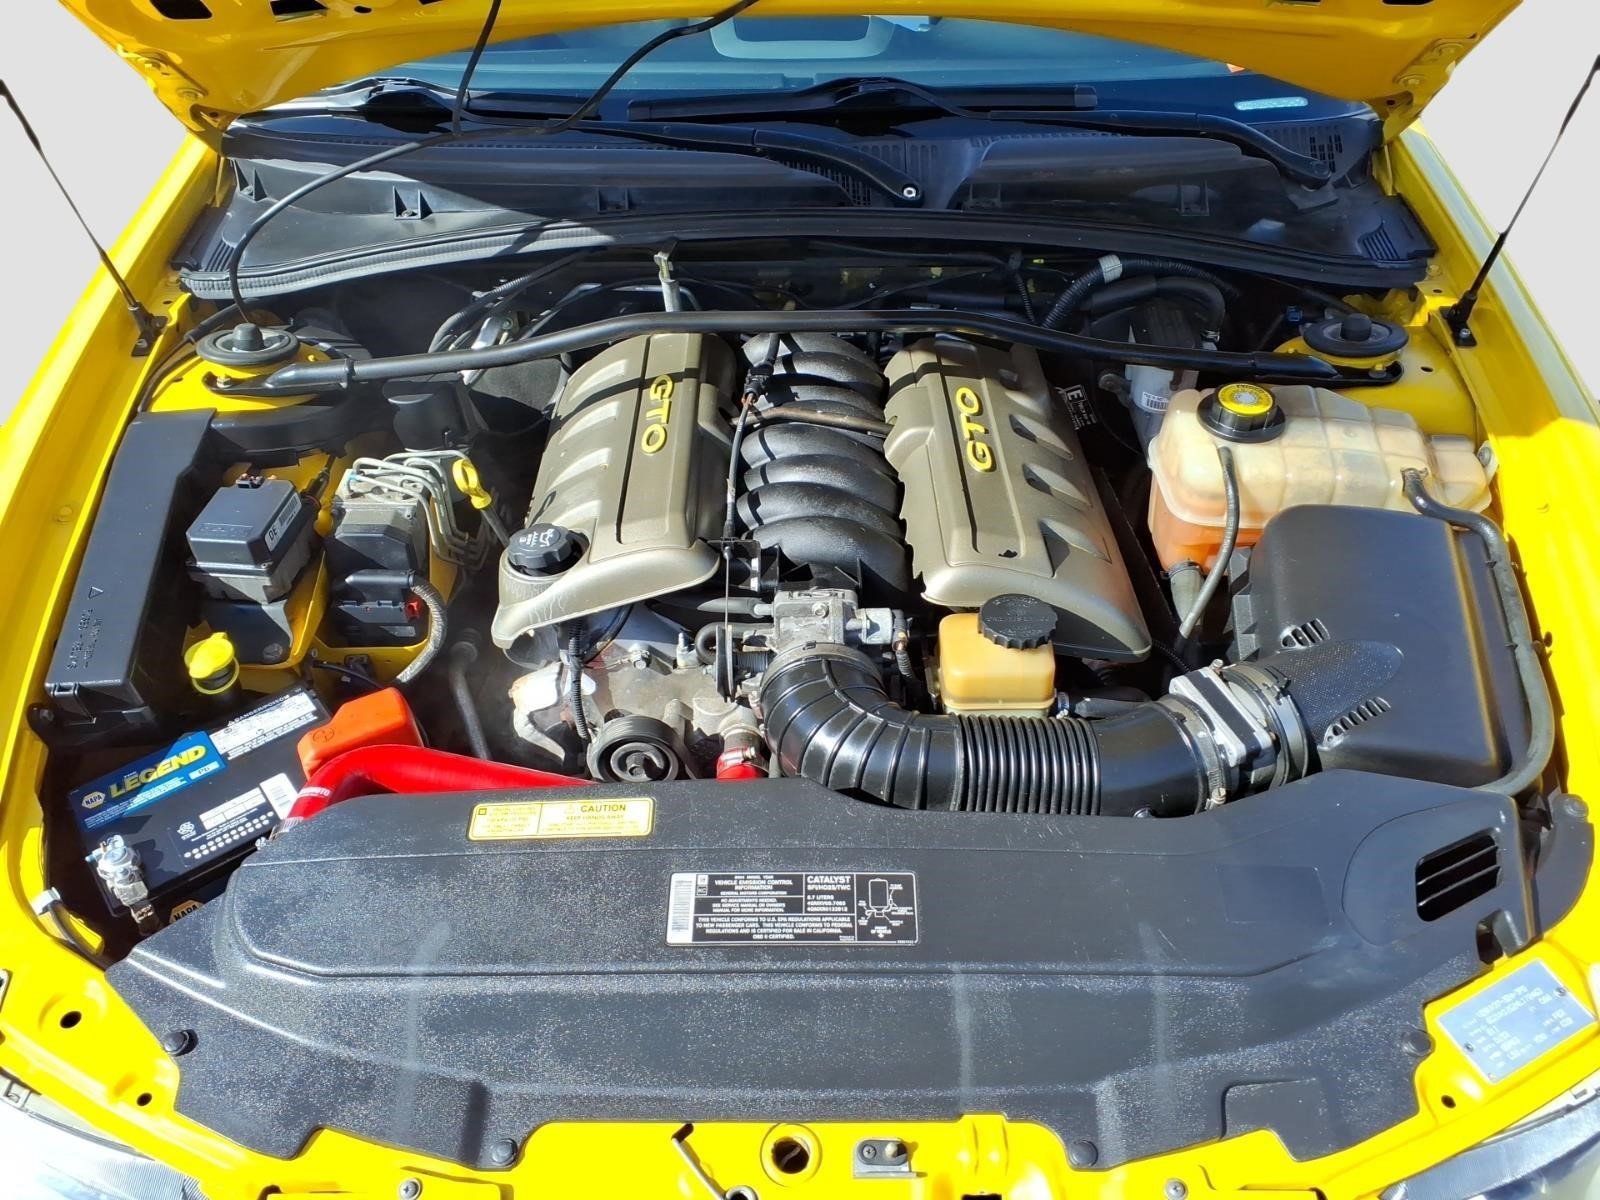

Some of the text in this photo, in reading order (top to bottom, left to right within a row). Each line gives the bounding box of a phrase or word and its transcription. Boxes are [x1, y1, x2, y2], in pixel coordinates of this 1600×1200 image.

[641, 374, 674, 456] GTO
[955, 386, 997, 473] GTO
[109, 744, 207, 799] LEGEND
[85, 794, 103, 806] NAPA
[580, 803, 626, 813] CAUTION
[807, 875, 851, 884] CATALYST
